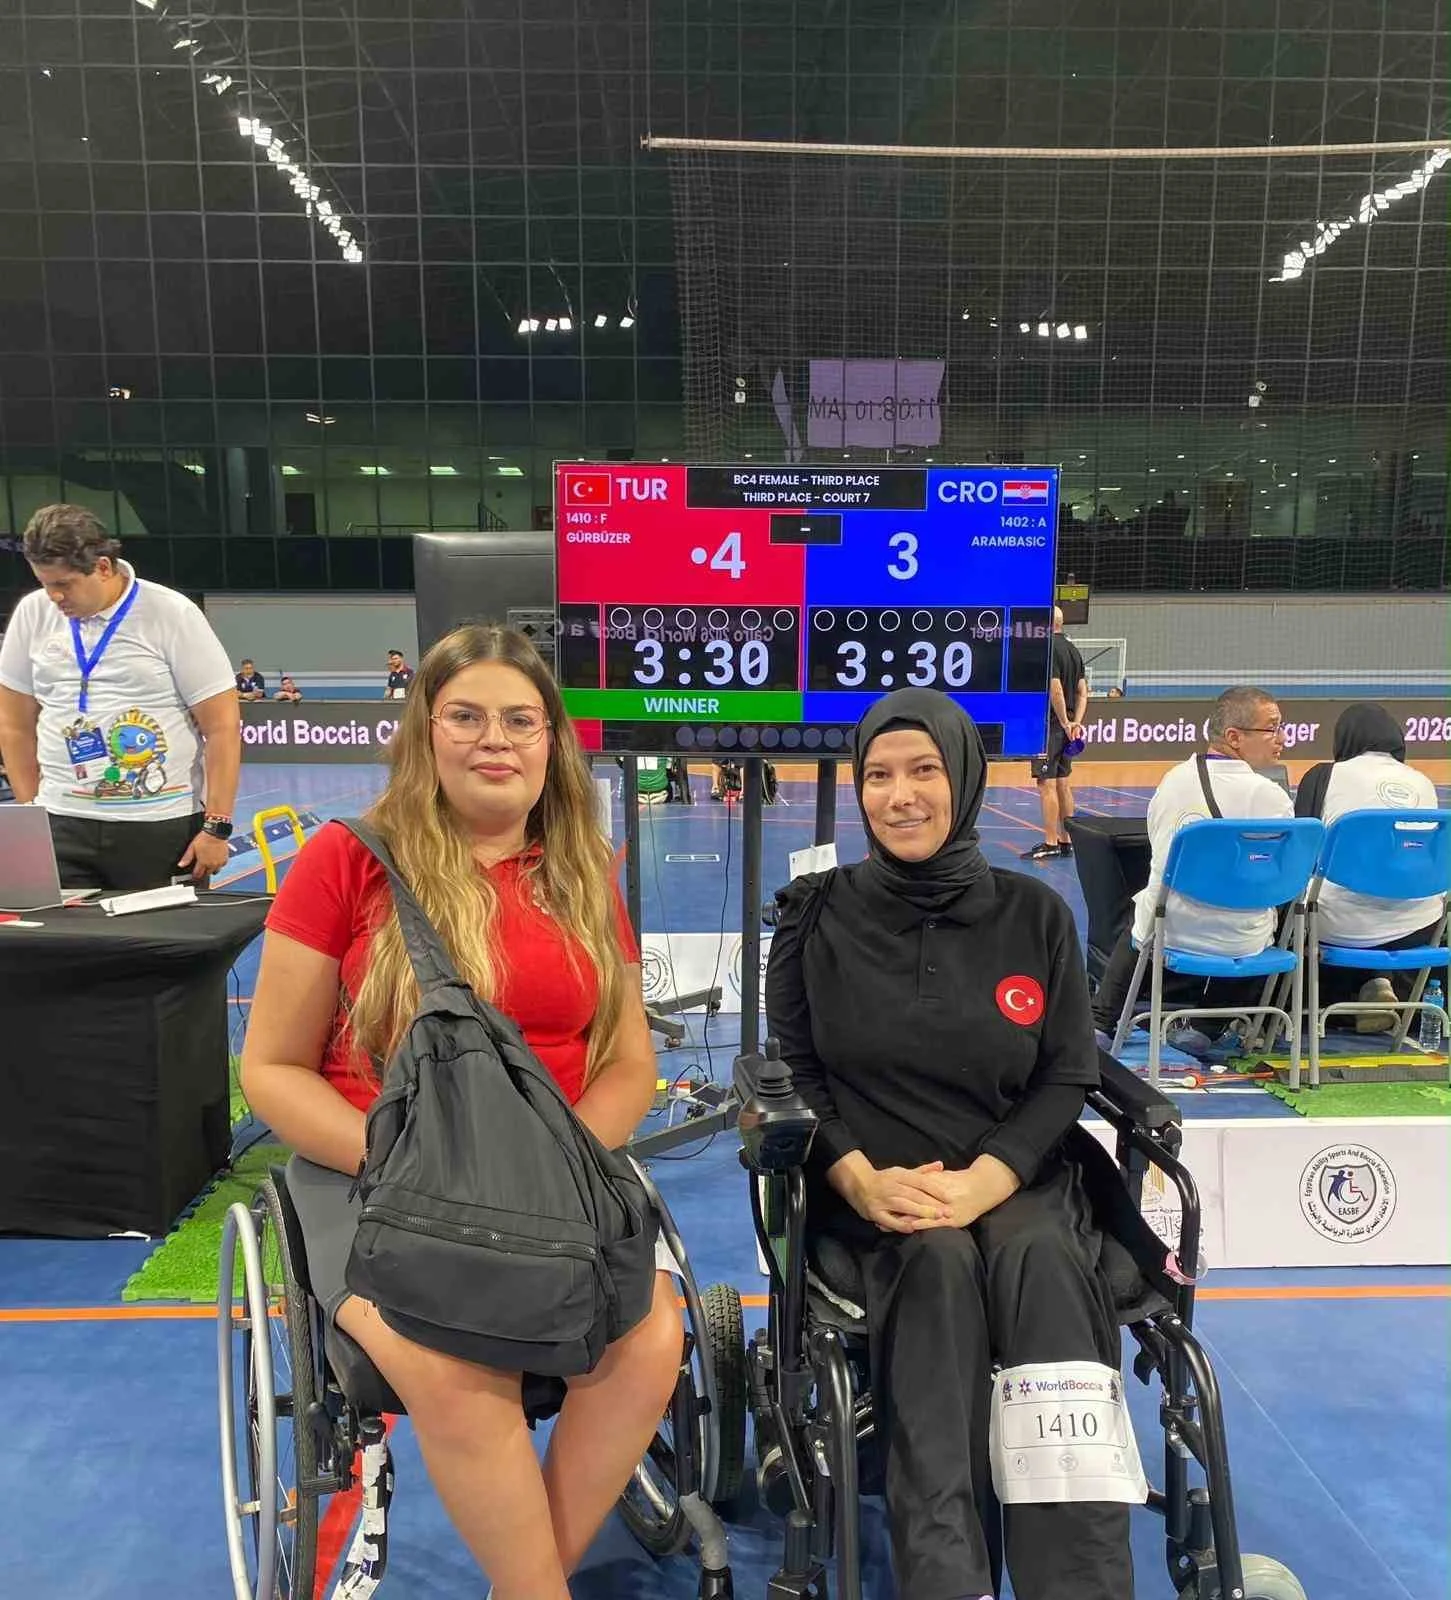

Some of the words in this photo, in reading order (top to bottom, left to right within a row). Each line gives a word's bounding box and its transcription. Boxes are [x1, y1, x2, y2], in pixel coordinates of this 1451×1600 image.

[616, 477, 668, 501] TUR
[733, 475, 757, 486] BC4
[759, 475, 800, 486] FEMALE
[810, 475, 844, 486] THIRD
[845, 476, 880, 486] PLACE
[743, 493, 776, 503] THIRD
[777, 493, 811, 503] PLACE
[822, 493, 862, 503] COURT
[863, 493, 871, 503] 7
[937, 480, 998, 504] CRO
[566, 512, 592, 524] 1410
[600, 513, 608, 524] F
[1000, 516, 1029, 528] 1402
[1037, 517, 1047, 528] A
[566, 531, 632, 544] GÜRBÜZER
[970, 535, 1047, 548] ARAMBASIC
[887, 531, 919, 580] 3
[633, 638, 769, 686] 3:30
[835, 640, 973, 687] 3:30
[643, 697, 720, 714] WINNER
[240, 719, 288, 745] orld
[293, 719, 370, 745] Boccia
[1123, 717, 1197, 743] Boccia
[1404, 716, 1451, 742] 2026
[1327, 1150, 1347, 1160] Sports
[1347, 1149, 1360, 1157] And
[1338, 1207, 1360, 1216] EASBF
[1036, 1412, 1098, 1439] 1410
